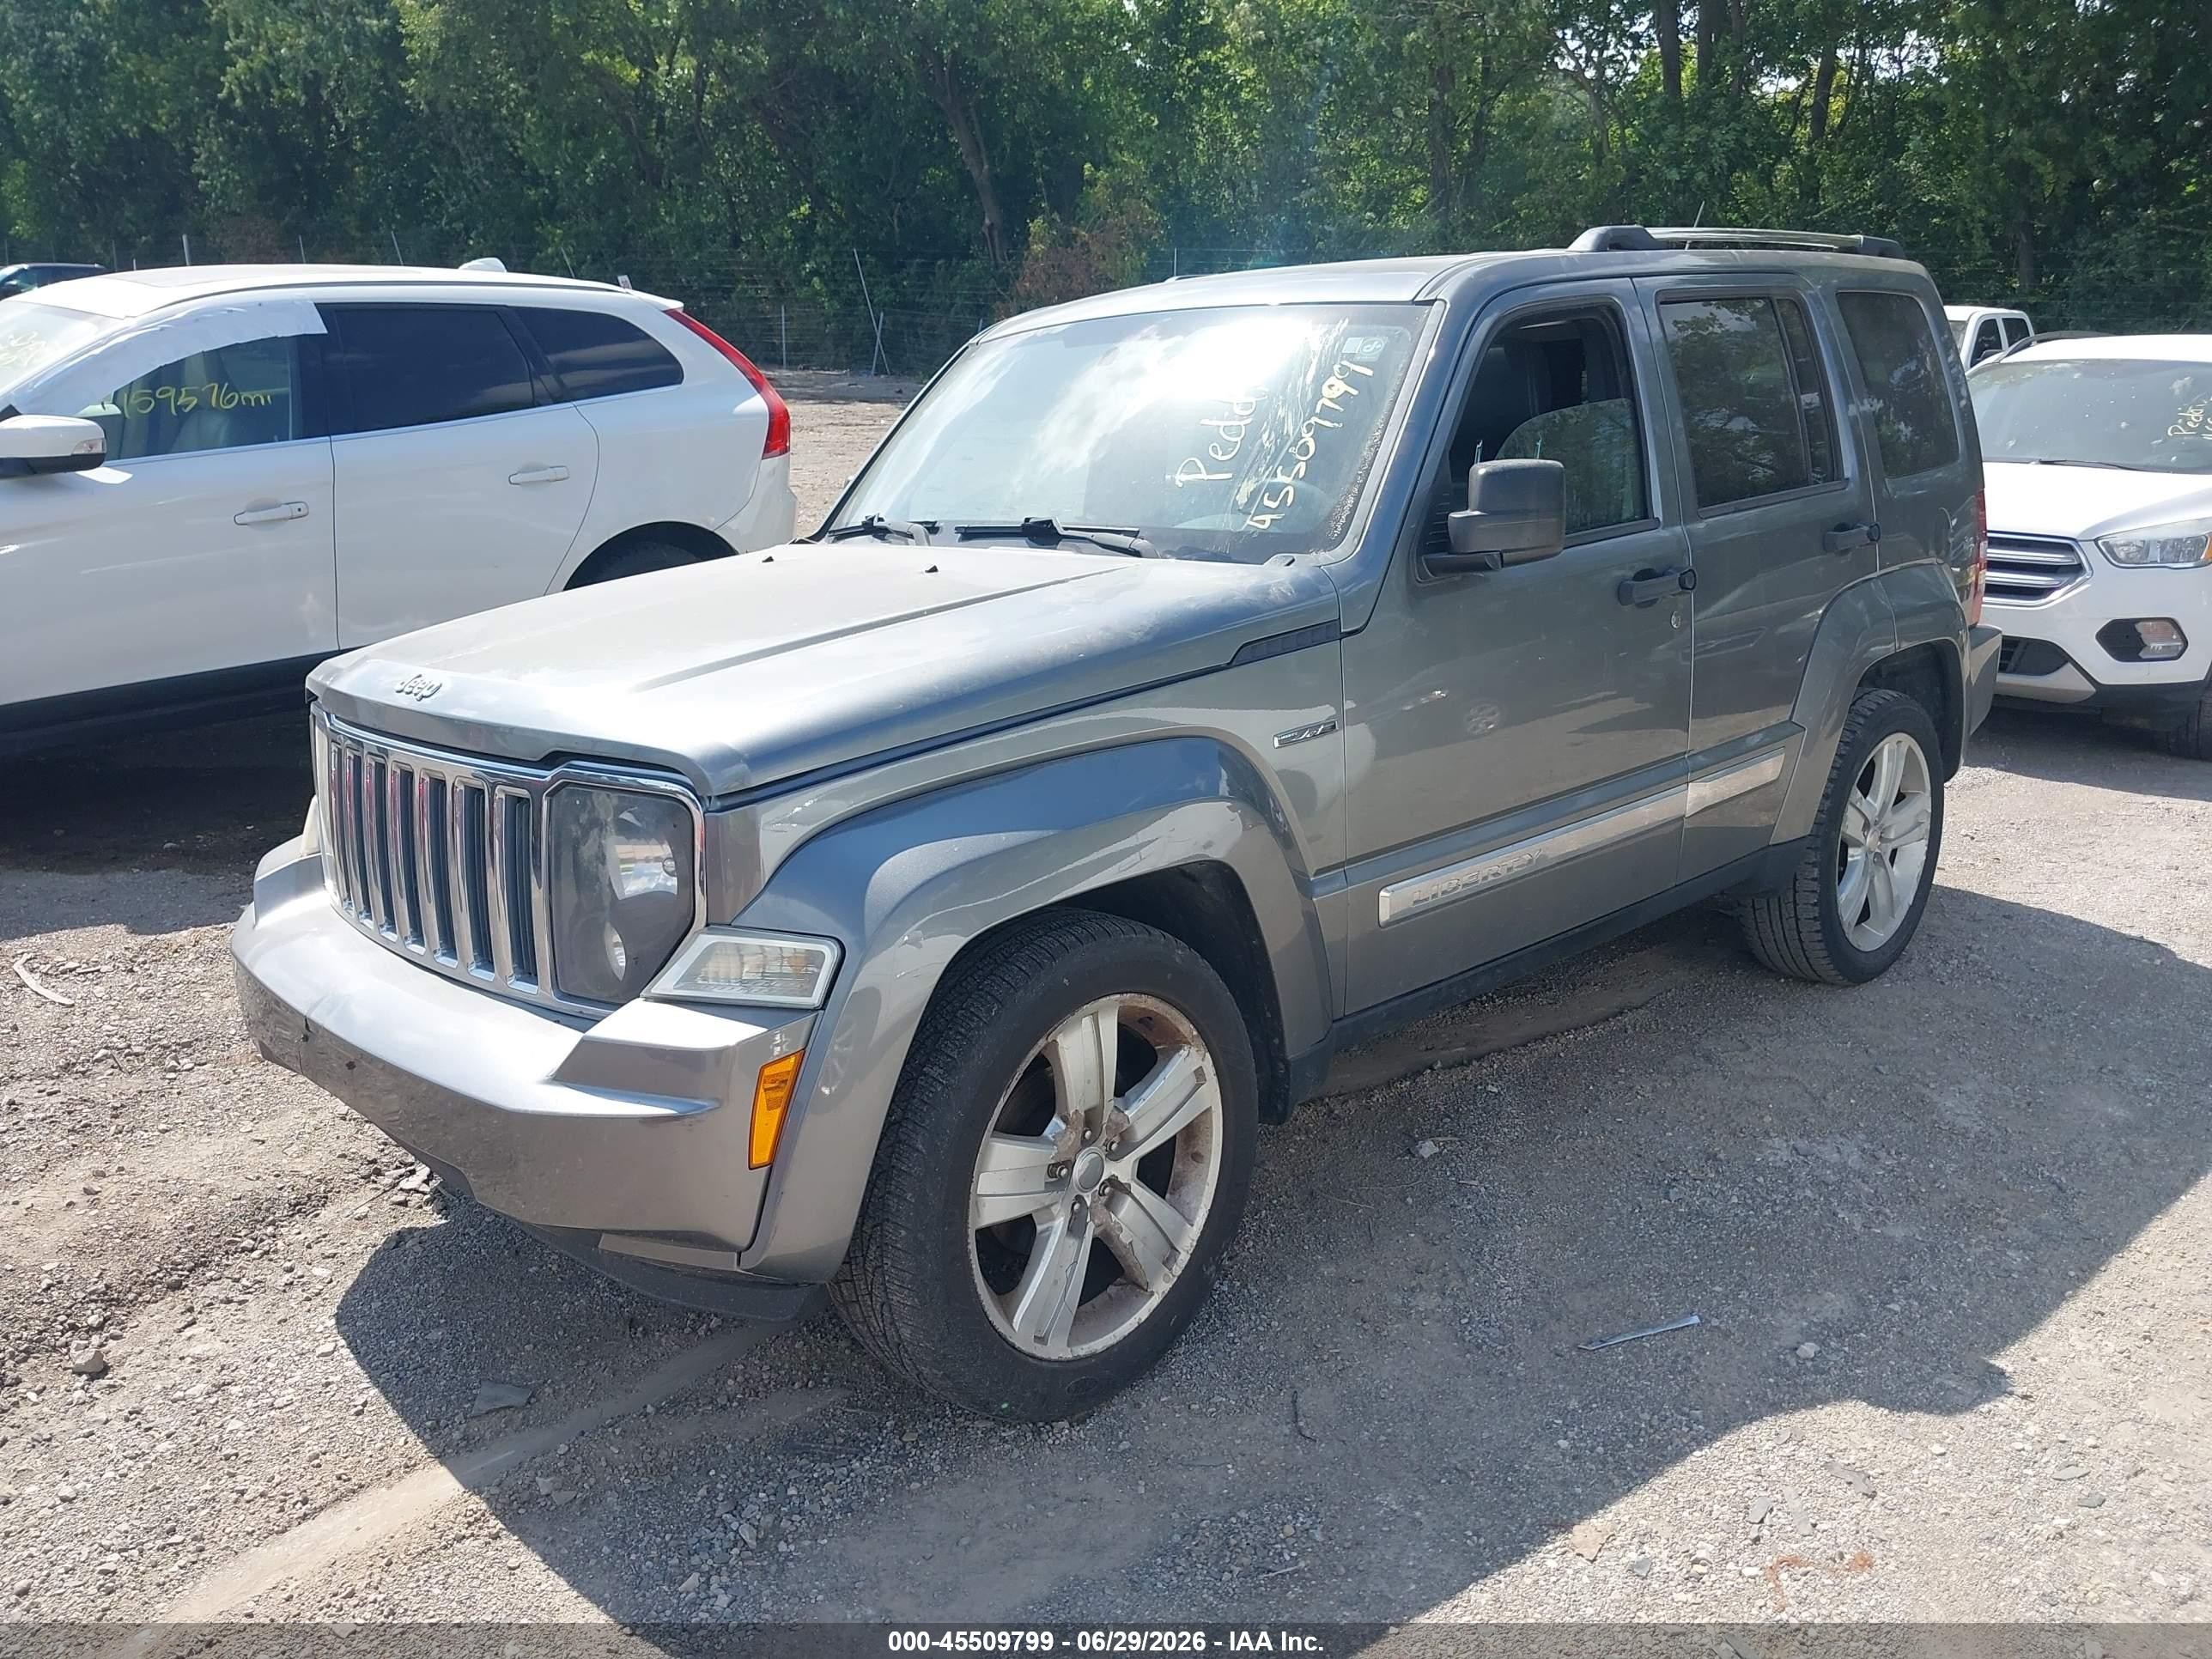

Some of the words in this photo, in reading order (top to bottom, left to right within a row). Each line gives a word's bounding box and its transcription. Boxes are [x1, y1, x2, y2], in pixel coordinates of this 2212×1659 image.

[1246, 359, 1374, 530] 45509799
[395, 673, 443, 702] Jeep
[1413, 848, 1543, 907] LIBERTY
